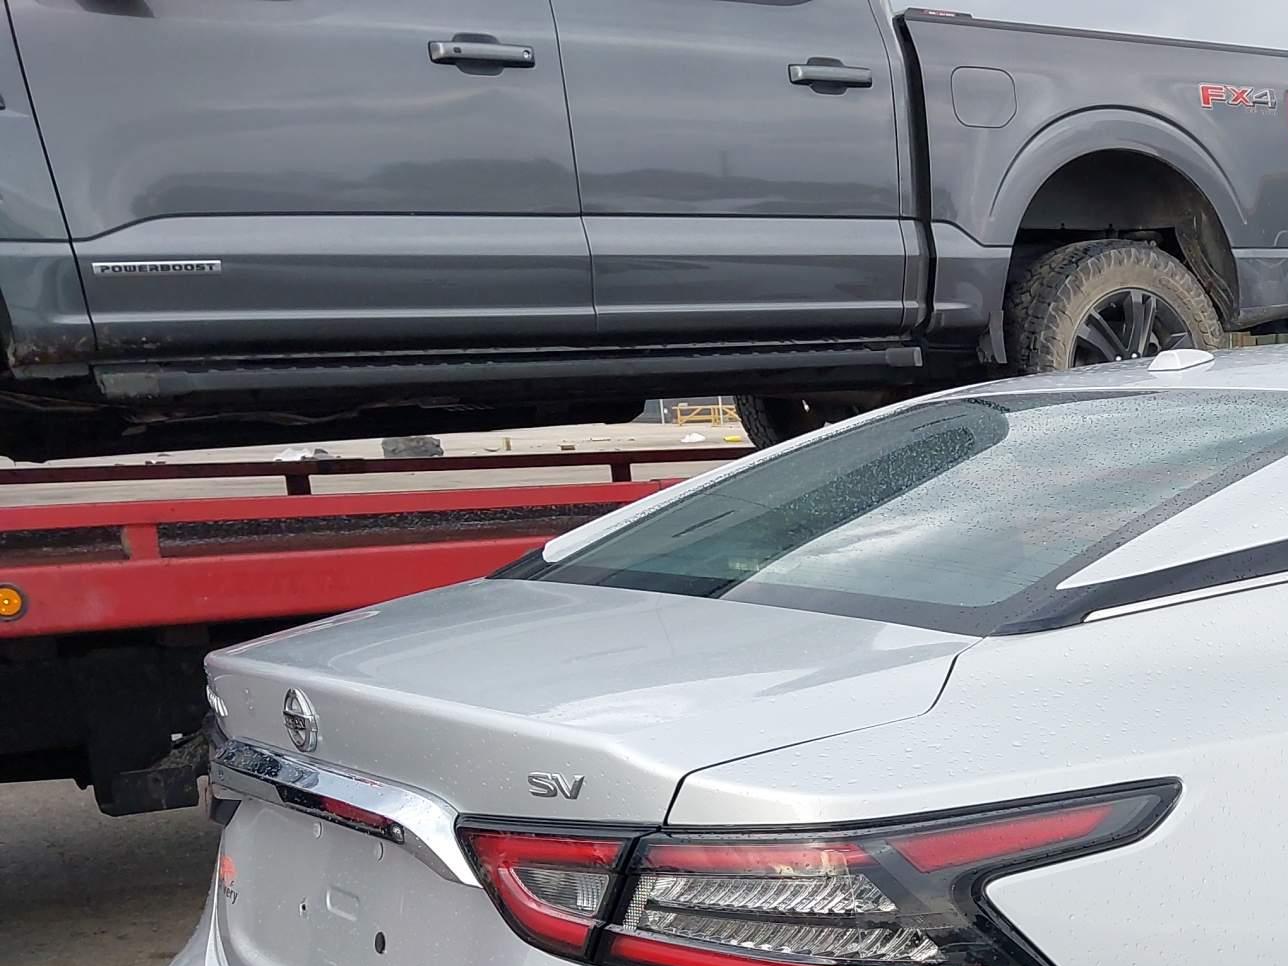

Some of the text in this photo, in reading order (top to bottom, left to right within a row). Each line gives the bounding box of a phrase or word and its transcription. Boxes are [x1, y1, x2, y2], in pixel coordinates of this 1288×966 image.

[1200, 84, 1276, 109] FX4
[100, 263, 216, 272] POWERBOOST
[527, 772, 585, 799] SV
